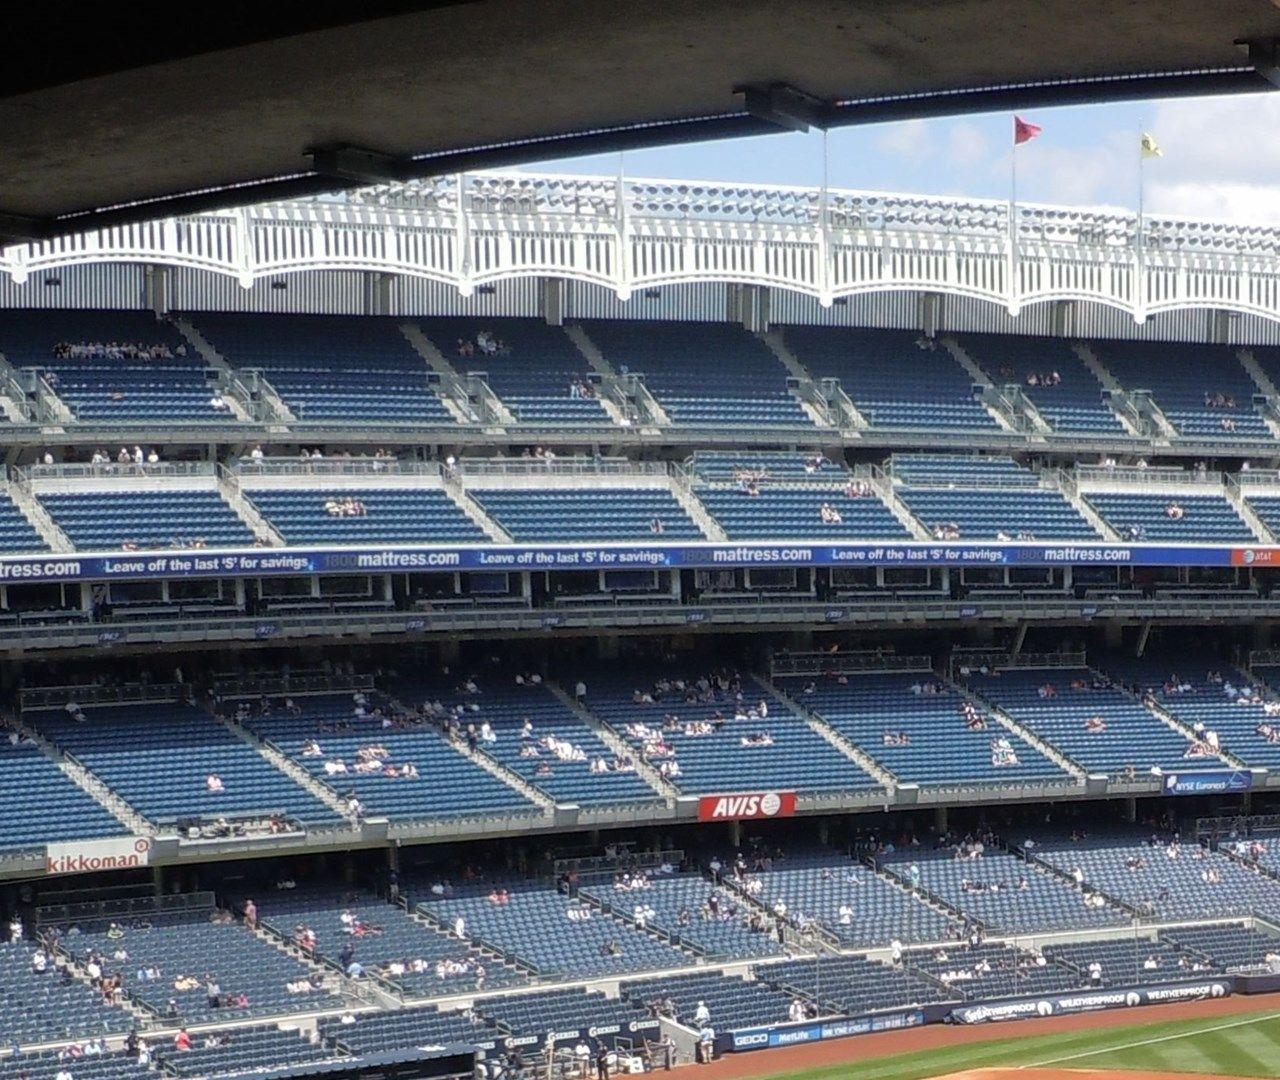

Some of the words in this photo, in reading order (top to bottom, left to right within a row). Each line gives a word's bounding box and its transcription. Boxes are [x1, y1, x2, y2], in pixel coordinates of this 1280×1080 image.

[105, 561, 147, 574] Leave
[148, 559, 167, 572] off
[169, 559, 191, 571] the
[195, 559, 219, 570] last
[240, 557, 259, 569] for
[261, 557, 309, 570] savings
[712, 796, 760, 817] AVIS
[46, 854, 138, 873] kikkoman
[1146, 985, 1212, 1001] WEATHERPROOF
